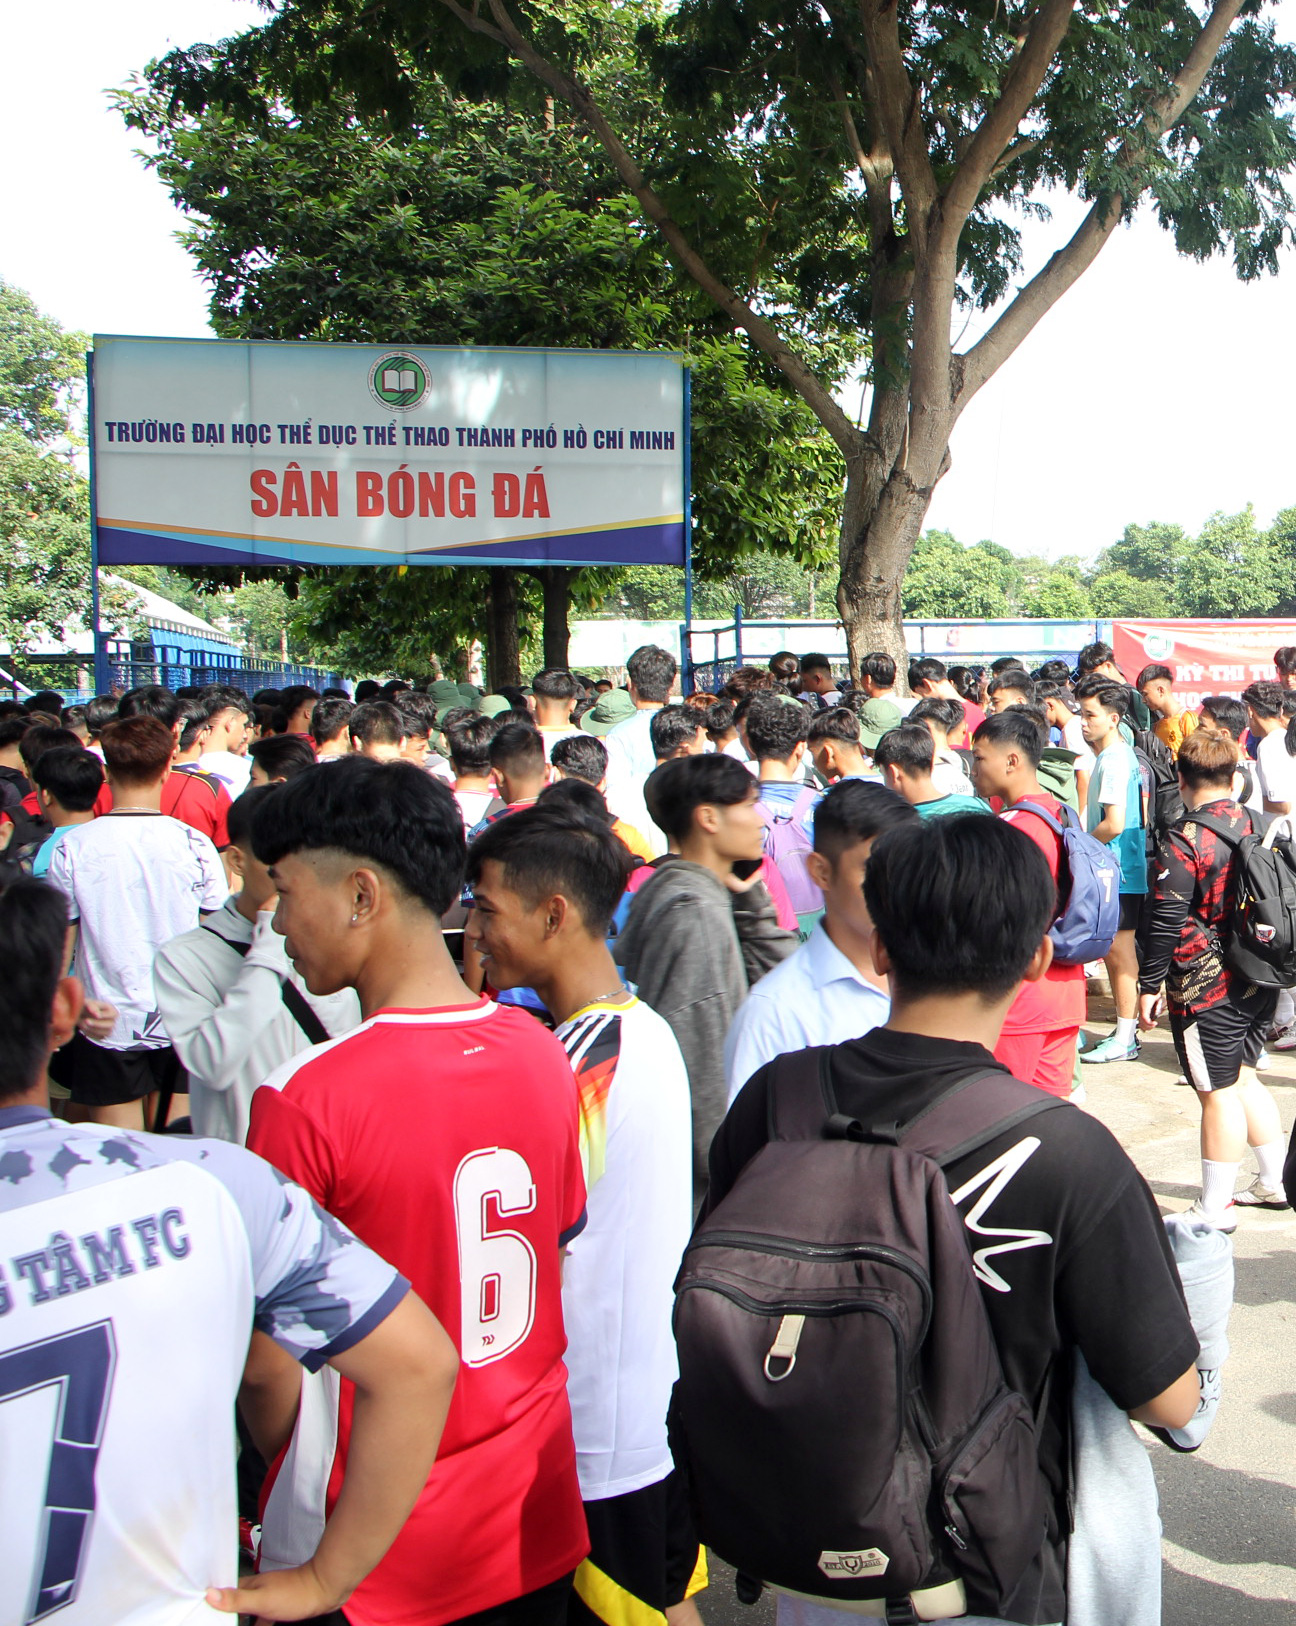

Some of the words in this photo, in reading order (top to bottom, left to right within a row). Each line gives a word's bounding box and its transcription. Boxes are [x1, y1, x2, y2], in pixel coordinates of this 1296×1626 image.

[105, 419, 185, 443] TRƯỜNG
[192, 423, 225, 447] ĐẠI
[232, 424, 271, 448] HỌC
[278, 418, 312, 444] THỂ
[318, 425, 357, 448] DỤC
[363, 419, 397, 446] THỂ
[402, 426, 449, 446] THAO
[456, 424, 515, 447] THÀNH
[522, 423, 557, 448] PHỐ
[563, 423, 587, 449] HỒ
[593, 427, 624, 449] CHÍ
[630, 430, 675, 450] MINH
[250, 461, 338, 517] SÂN
[356, 464, 476, 518] BÓNG
[491, 466, 551, 518] ĐÁ
[1176, 662, 1204, 681] KỲ
[1209, 664, 1245, 681] THI
[11, 1230, 137, 1307] TÂM
[129, 1206, 192, 1271] FC
[453, 1146, 537, 1368] 6
